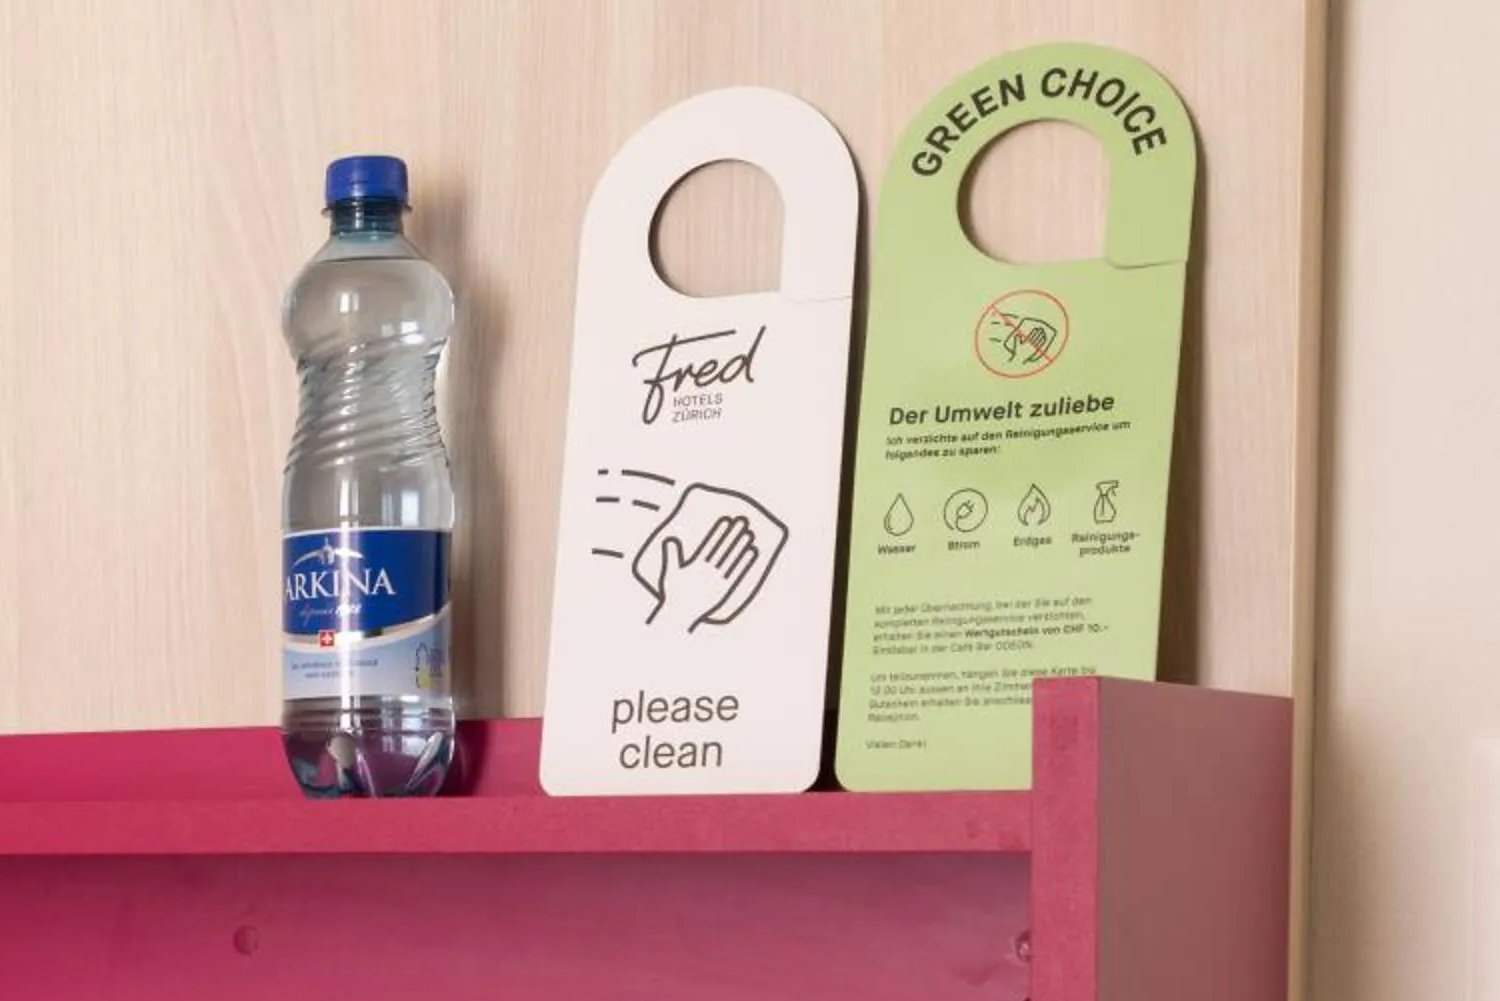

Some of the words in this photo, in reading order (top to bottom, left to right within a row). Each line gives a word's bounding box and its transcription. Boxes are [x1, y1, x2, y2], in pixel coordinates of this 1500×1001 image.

[911, 74, 1026, 177] GREEN
[1041, 67, 1167, 155] CHOICE
[632, 325, 766, 425] Fred
[673, 391, 723, 408] HOTELS
[889, 406, 928, 425] Der
[934, 401, 1023, 423] Umwelt
[1029, 393, 1115, 417] zuliebe
[671, 406, 723, 423] ZÜRICH
[886, 436, 903, 445] Ich
[906, 434, 958, 444] verzichte
[961, 431, 979, 442] auf
[981, 431, 1002, 441] den
[1005, 423, 1109, 441] Reinigungsservice
[1111, 421, 1131, 431] um
[885, 447, 940, 461] folgendes
[942, 448, 956, 457] zu
[877, 544, 916, 555] Wasser
[947, 540, 980, 551] Strom
[1013, 536, 1052, 549] Erdgas
[1079, 544, 1131, 558] produkte
[286, 567, 397, 601] ARKINA
[965, 628, 1039, 640] Wertgutschein
[1042, 626, 1060, 635] von
[1063, 624, 1085, 634] CHF
[611, 690, 740, 734] please
[619, 735, 723, 769] clean
